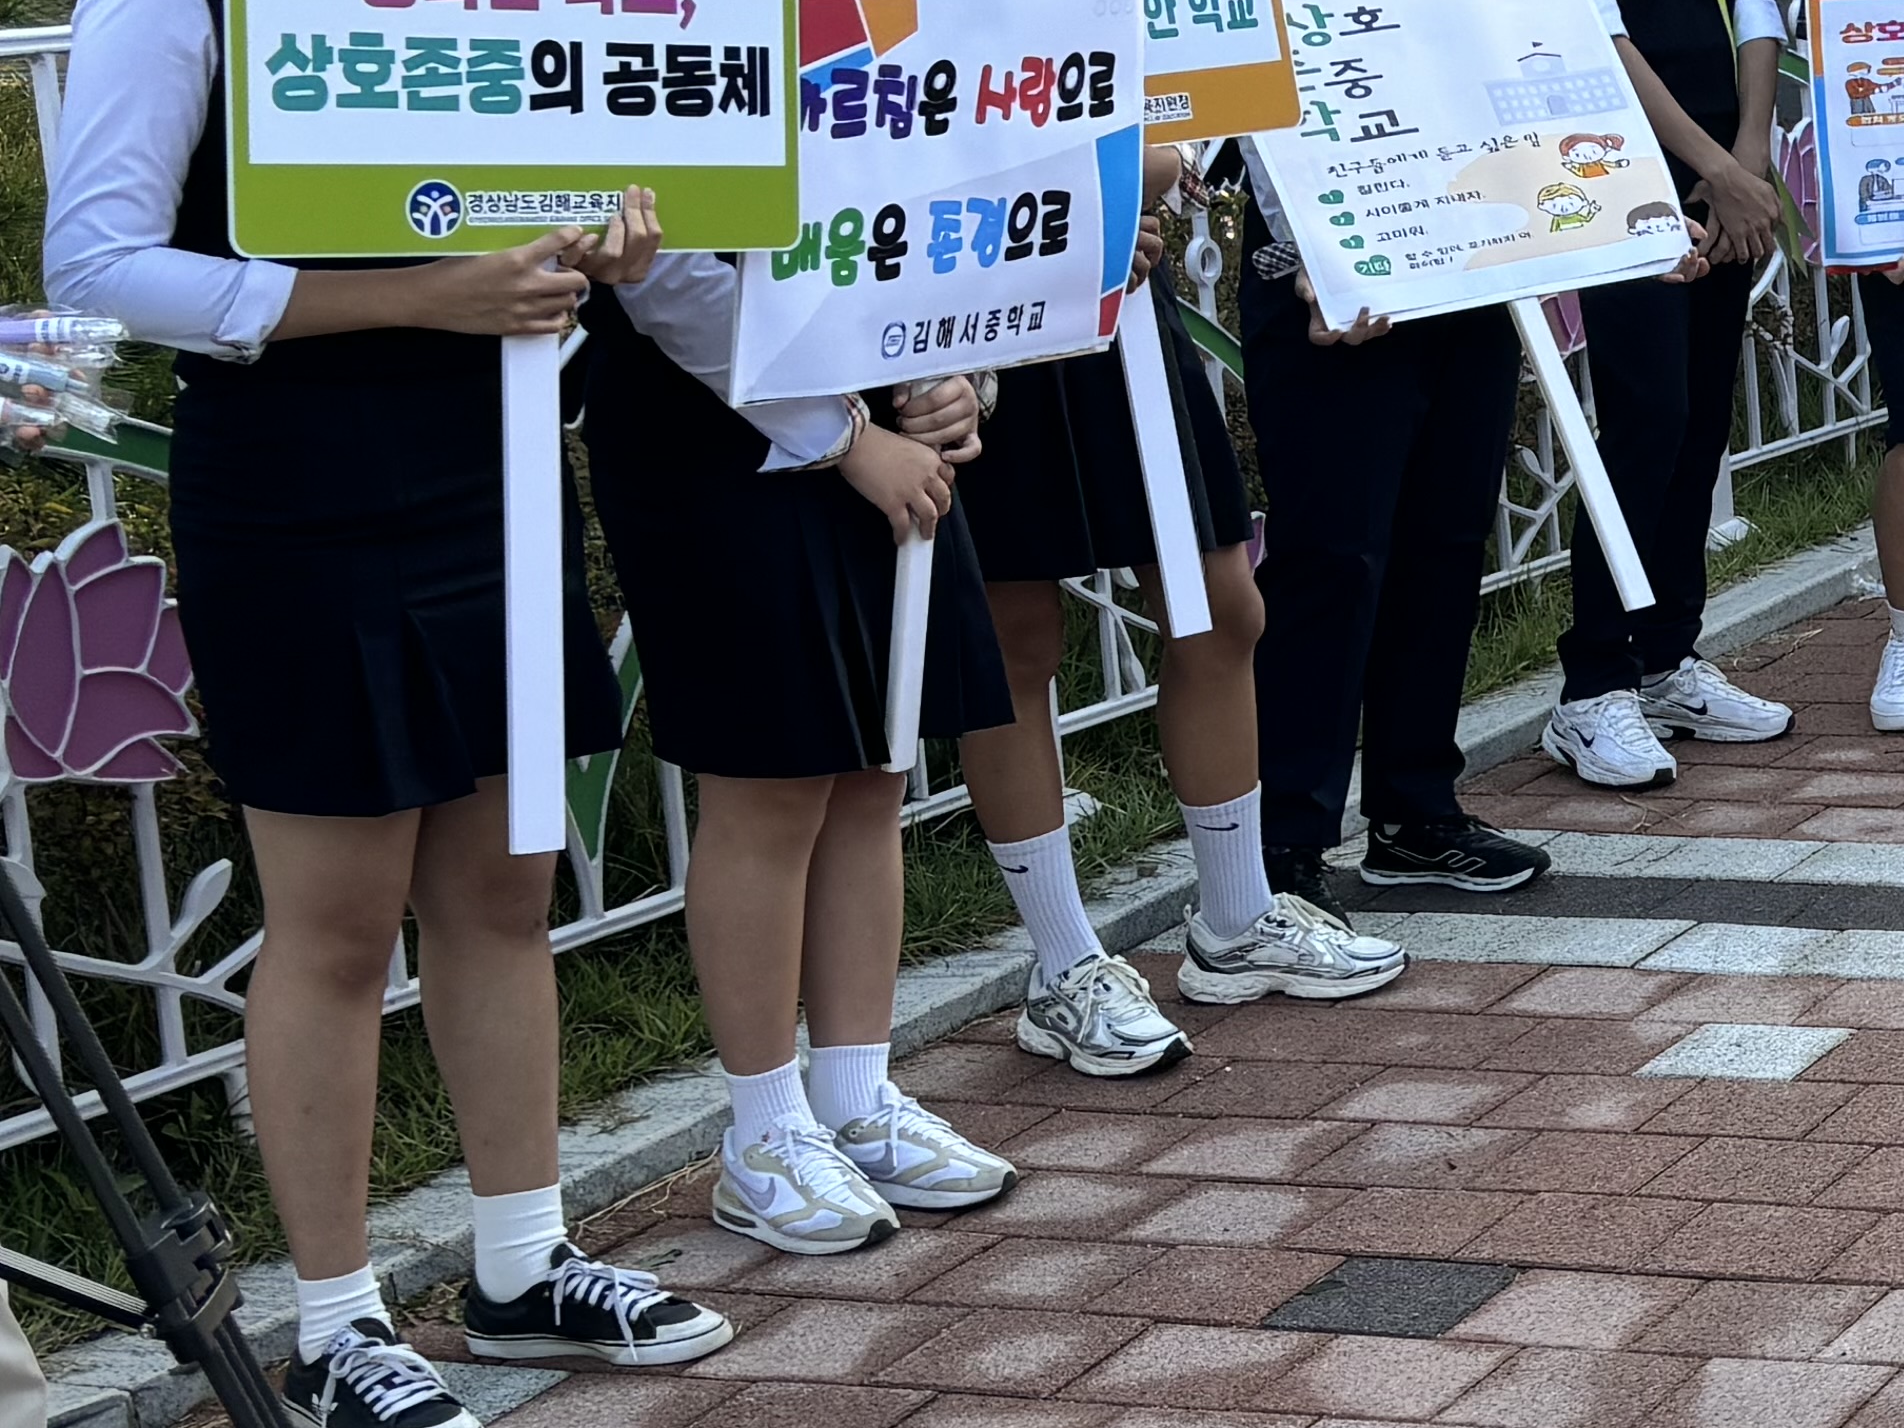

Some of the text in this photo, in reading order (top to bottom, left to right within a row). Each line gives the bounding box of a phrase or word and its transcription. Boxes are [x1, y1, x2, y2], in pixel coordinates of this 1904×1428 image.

[264, 32, 771, 118] 상호존중의 공동체
[974, 50, 1116, 127] 사랑으로
[468, 193, 621, 213] 경상남도김해교육지
[770, 190, 1071, 286] 배움은 존경으로
[912, 300, 1047, 355] 김해서중학교
